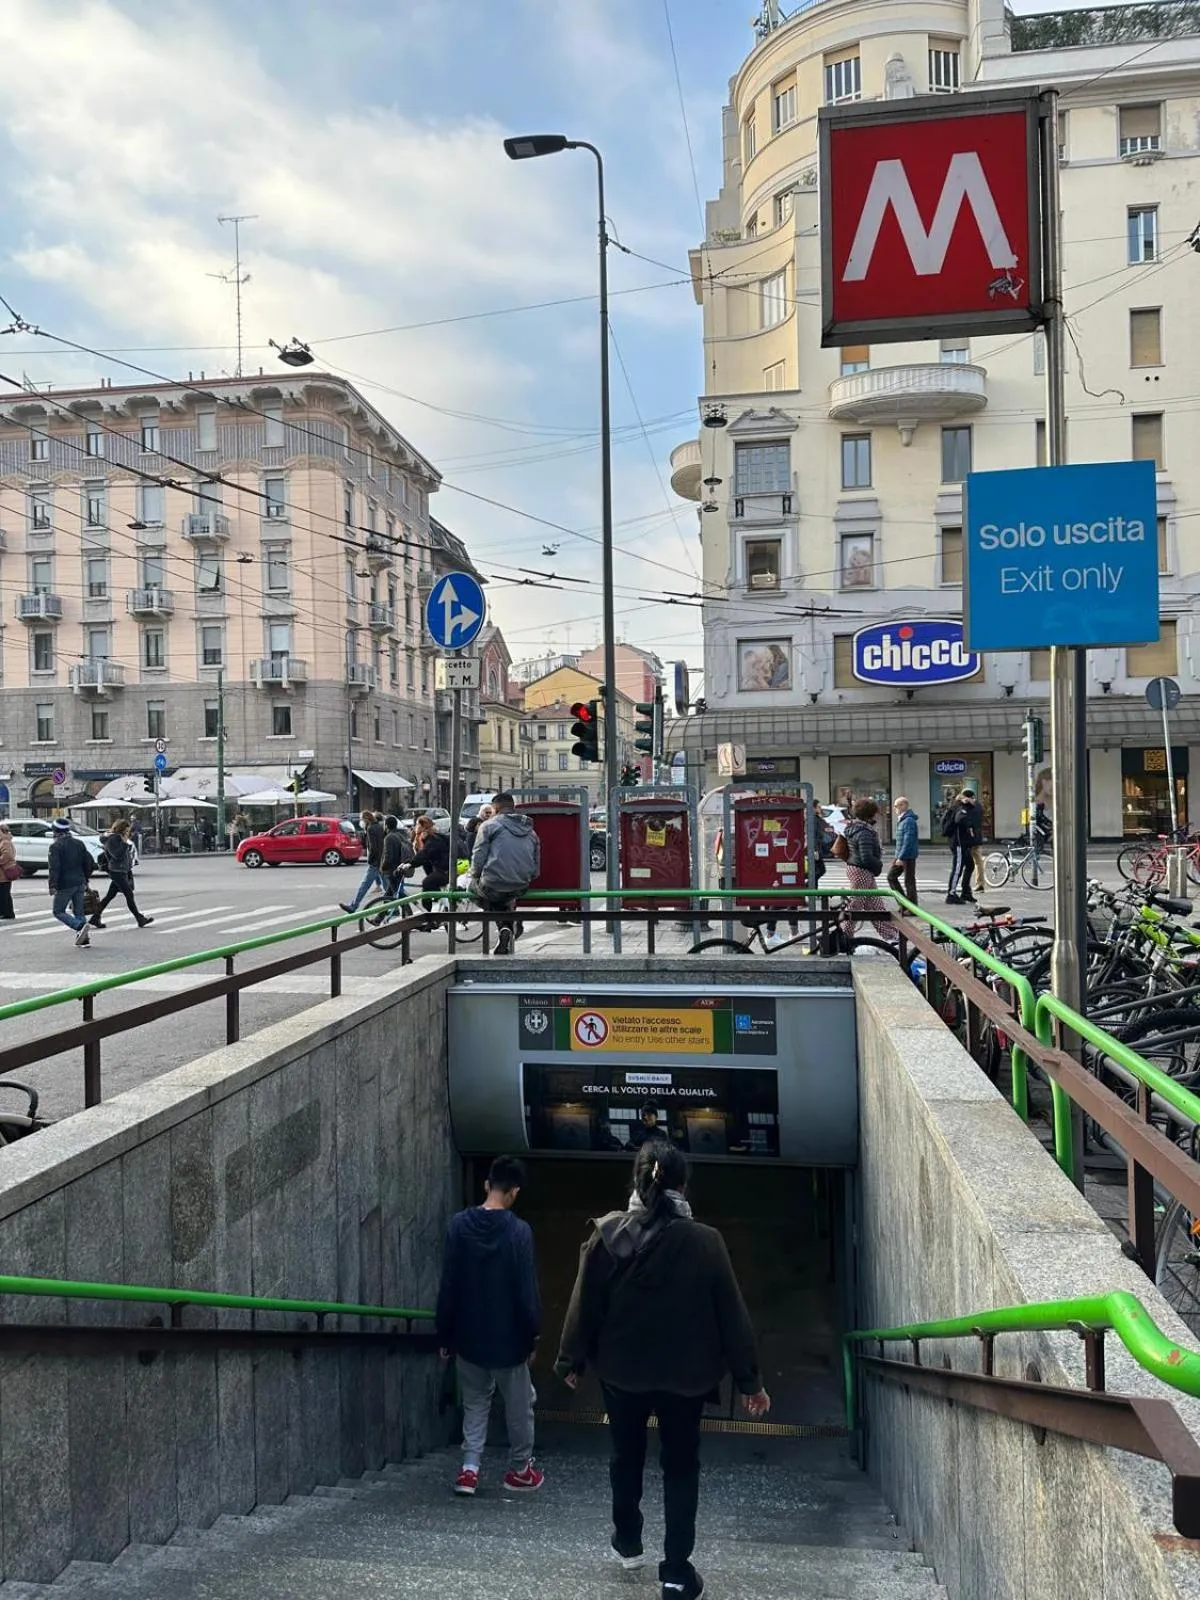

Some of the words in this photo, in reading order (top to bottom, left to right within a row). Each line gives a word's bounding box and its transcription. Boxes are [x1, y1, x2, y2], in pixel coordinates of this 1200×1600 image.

[842, 151, 1018, 281] M
[979, 522, 1046, 550] Solo
[1053, 516, 1145, 545] uscita
[1001, 566, 1054, 594] Exit
[1062, 562, 1124, 593] only
[863, 626, 971, 671] chicco
[937, 762, 966, 773] chicco
[612, 1016, 641, 1024] Vietato
[612, 1025, 649, 1033] Utilizzare
[660, 1026, 678, 1034] altre
[680, 1026, 702, 1035] scale
[612, 1036, 623, 1044] No
[625, 1036, 645, 1045] entry
[665, 1036, 686, 1045] other
[582, 1085, 610, 1093] CERCA
[620, 1086, 649, 1095] VOLTO
[650, 1087, 677, 1096] DELLA
